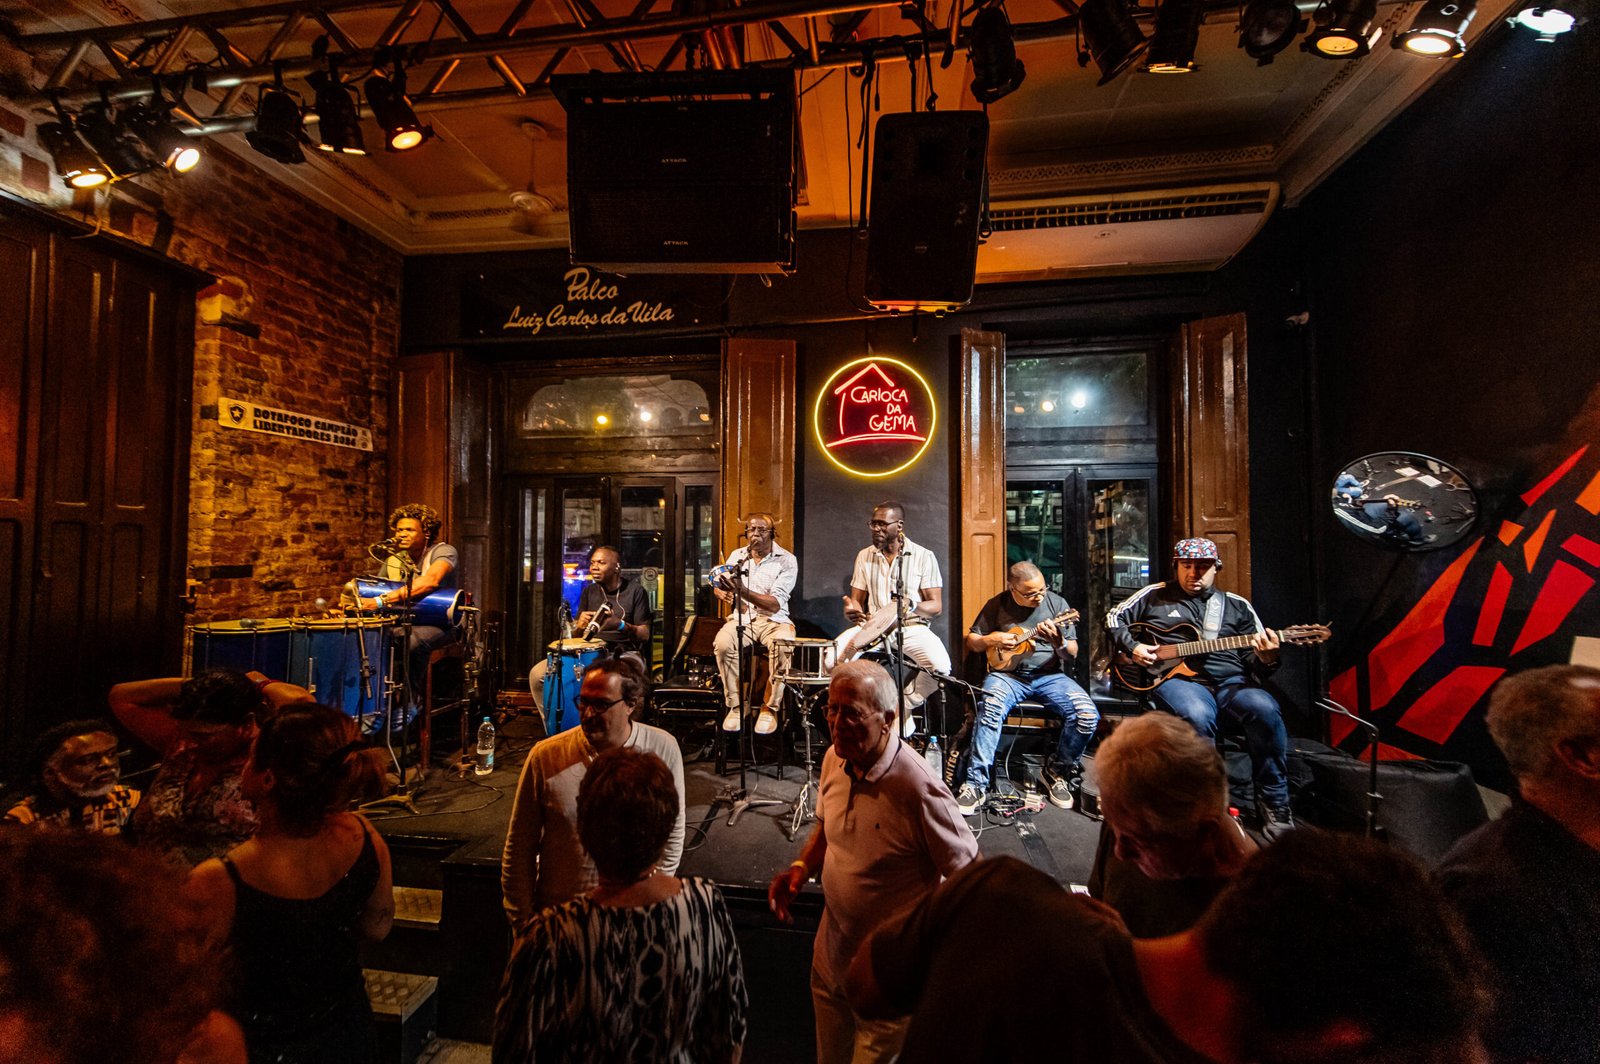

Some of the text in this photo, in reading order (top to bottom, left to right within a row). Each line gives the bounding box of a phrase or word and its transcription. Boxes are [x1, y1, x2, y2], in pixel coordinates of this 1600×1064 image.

[563, 267, 619, 302] Palco
[503, 301, 675, 335] Luiz Carlos da Vila
[851, 386, 909, 403] CARIOCA
[253, 407, 312, 428] BOTAFOGO
[887, 403, 902, 415] DA
[253, 419, 331, 442] LIBERTADORES
[869, 414, 917, 432] GEMA
